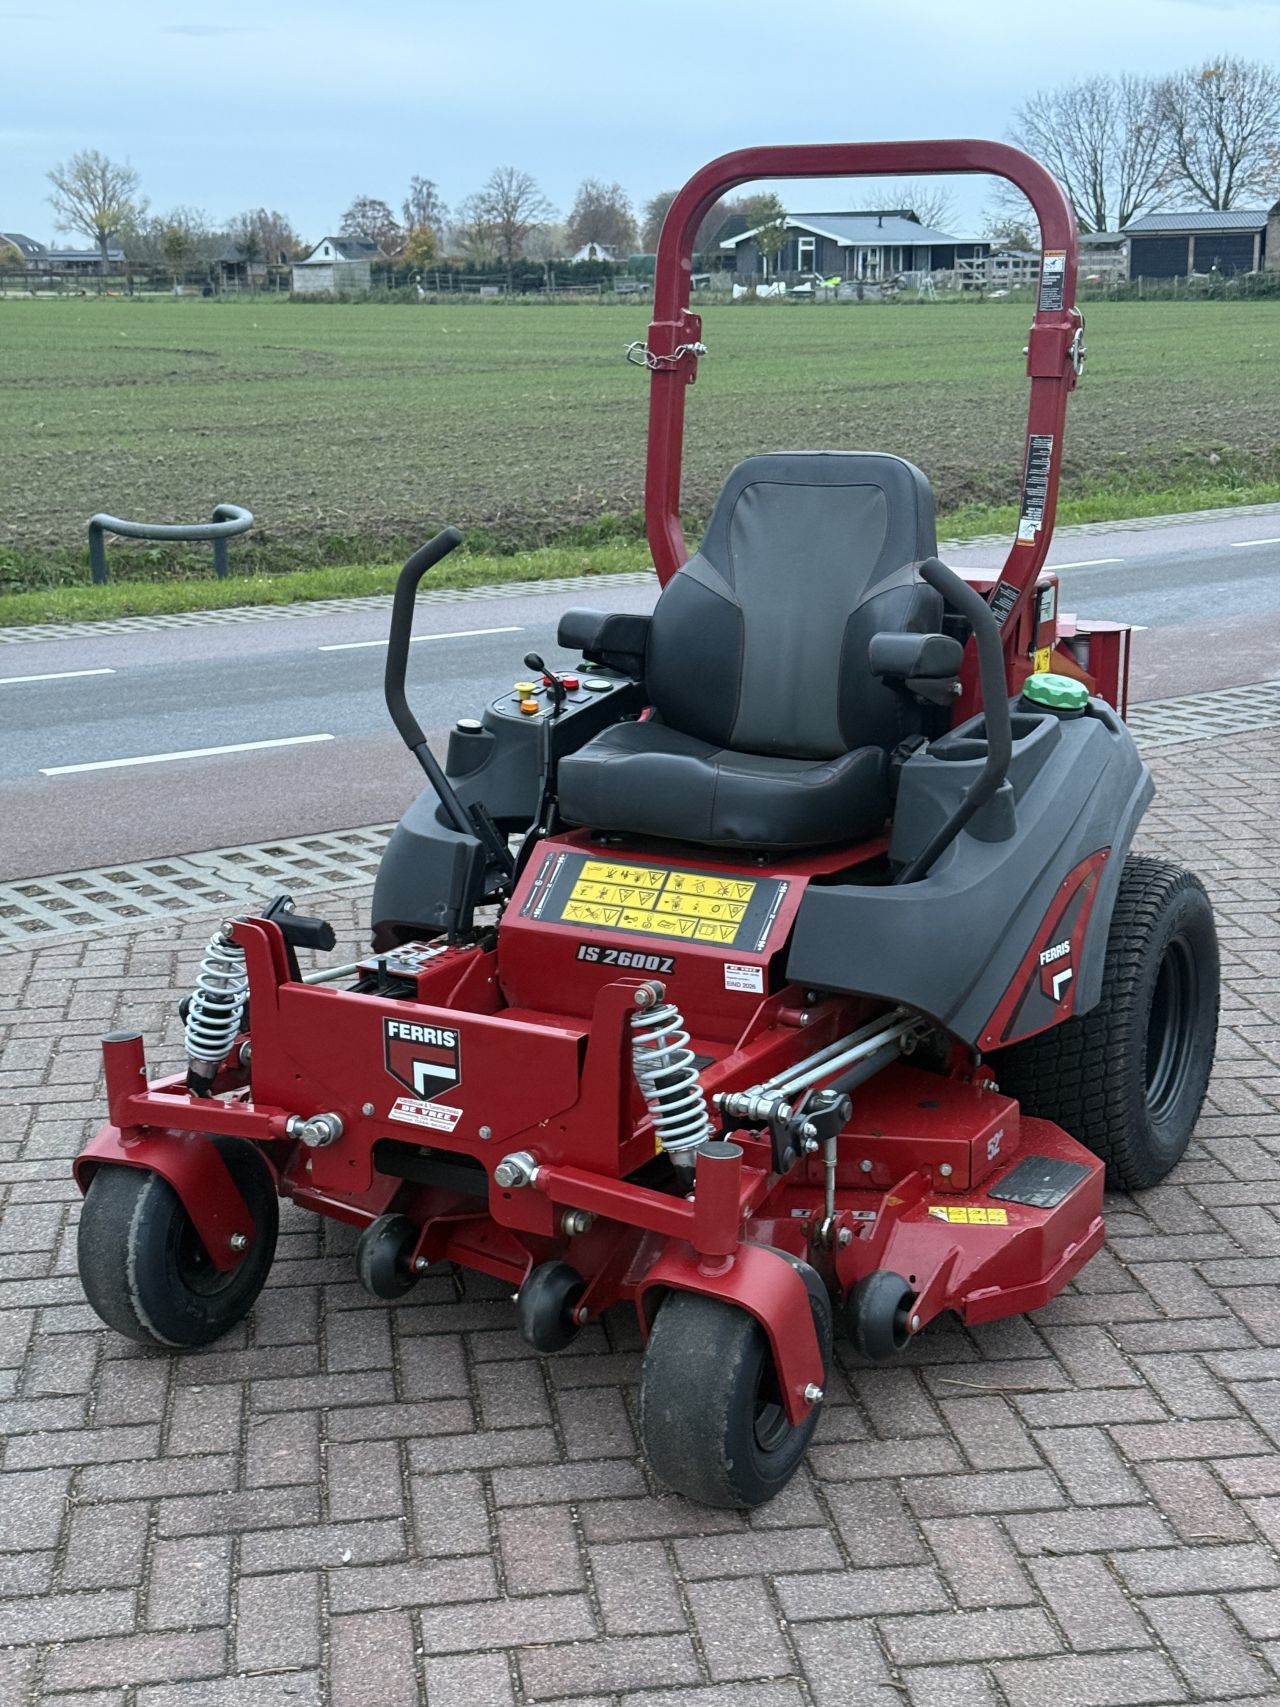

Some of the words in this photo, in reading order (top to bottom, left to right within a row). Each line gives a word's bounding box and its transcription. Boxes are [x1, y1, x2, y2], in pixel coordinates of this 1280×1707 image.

[577, 945, 600, 961] IS
[602, 949, 674, 974] 2600Z
[1039, 940, 1070, 966] FERRIS
[388, 1021, 455, 1048] FERRIS
[401, 1104, 417, 1113] DE
[421, 1108, 452, 1121] VREE
